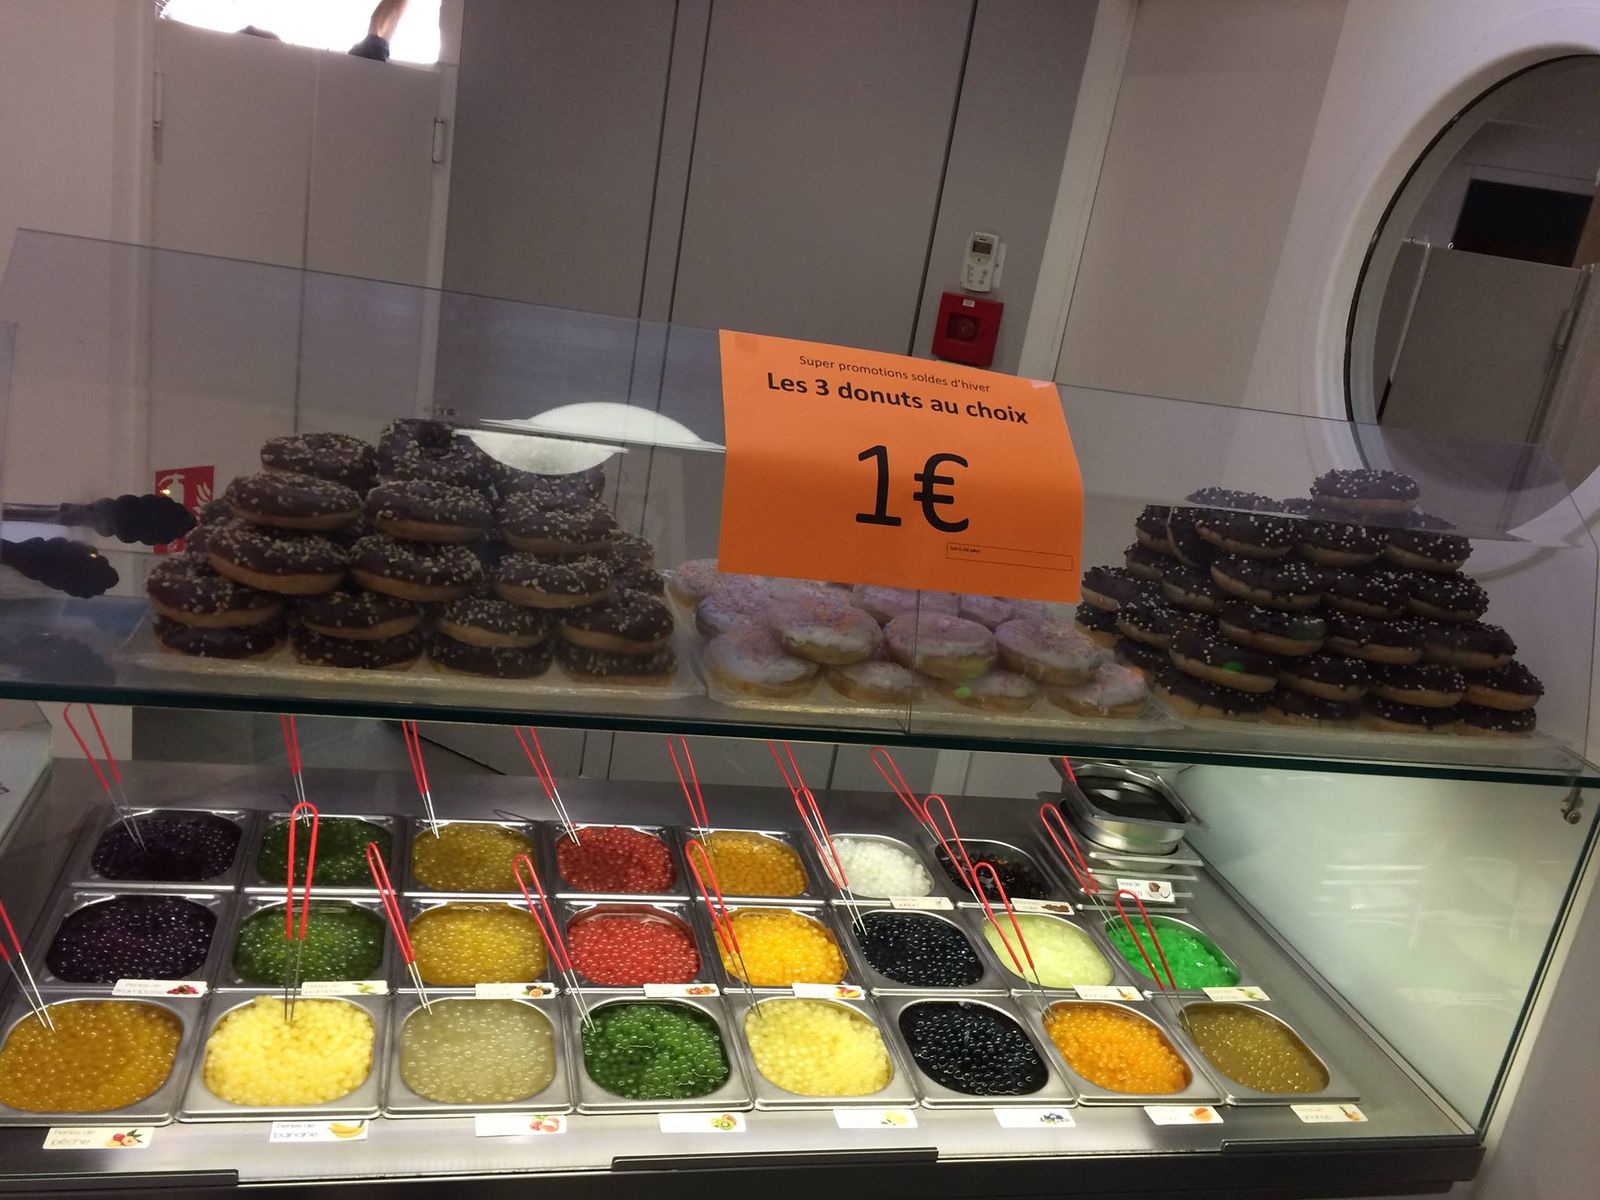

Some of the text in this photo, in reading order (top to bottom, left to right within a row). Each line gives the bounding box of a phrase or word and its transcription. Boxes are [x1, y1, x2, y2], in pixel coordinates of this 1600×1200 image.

[799, 355, 835, 369] Super
[838, 363, 909, 380] promotions
[911, 374, 948, 387] soldes
[767, 372, 1029, 425] Les 3 donuts au choix
[855, 445, 970, 533] 1€
